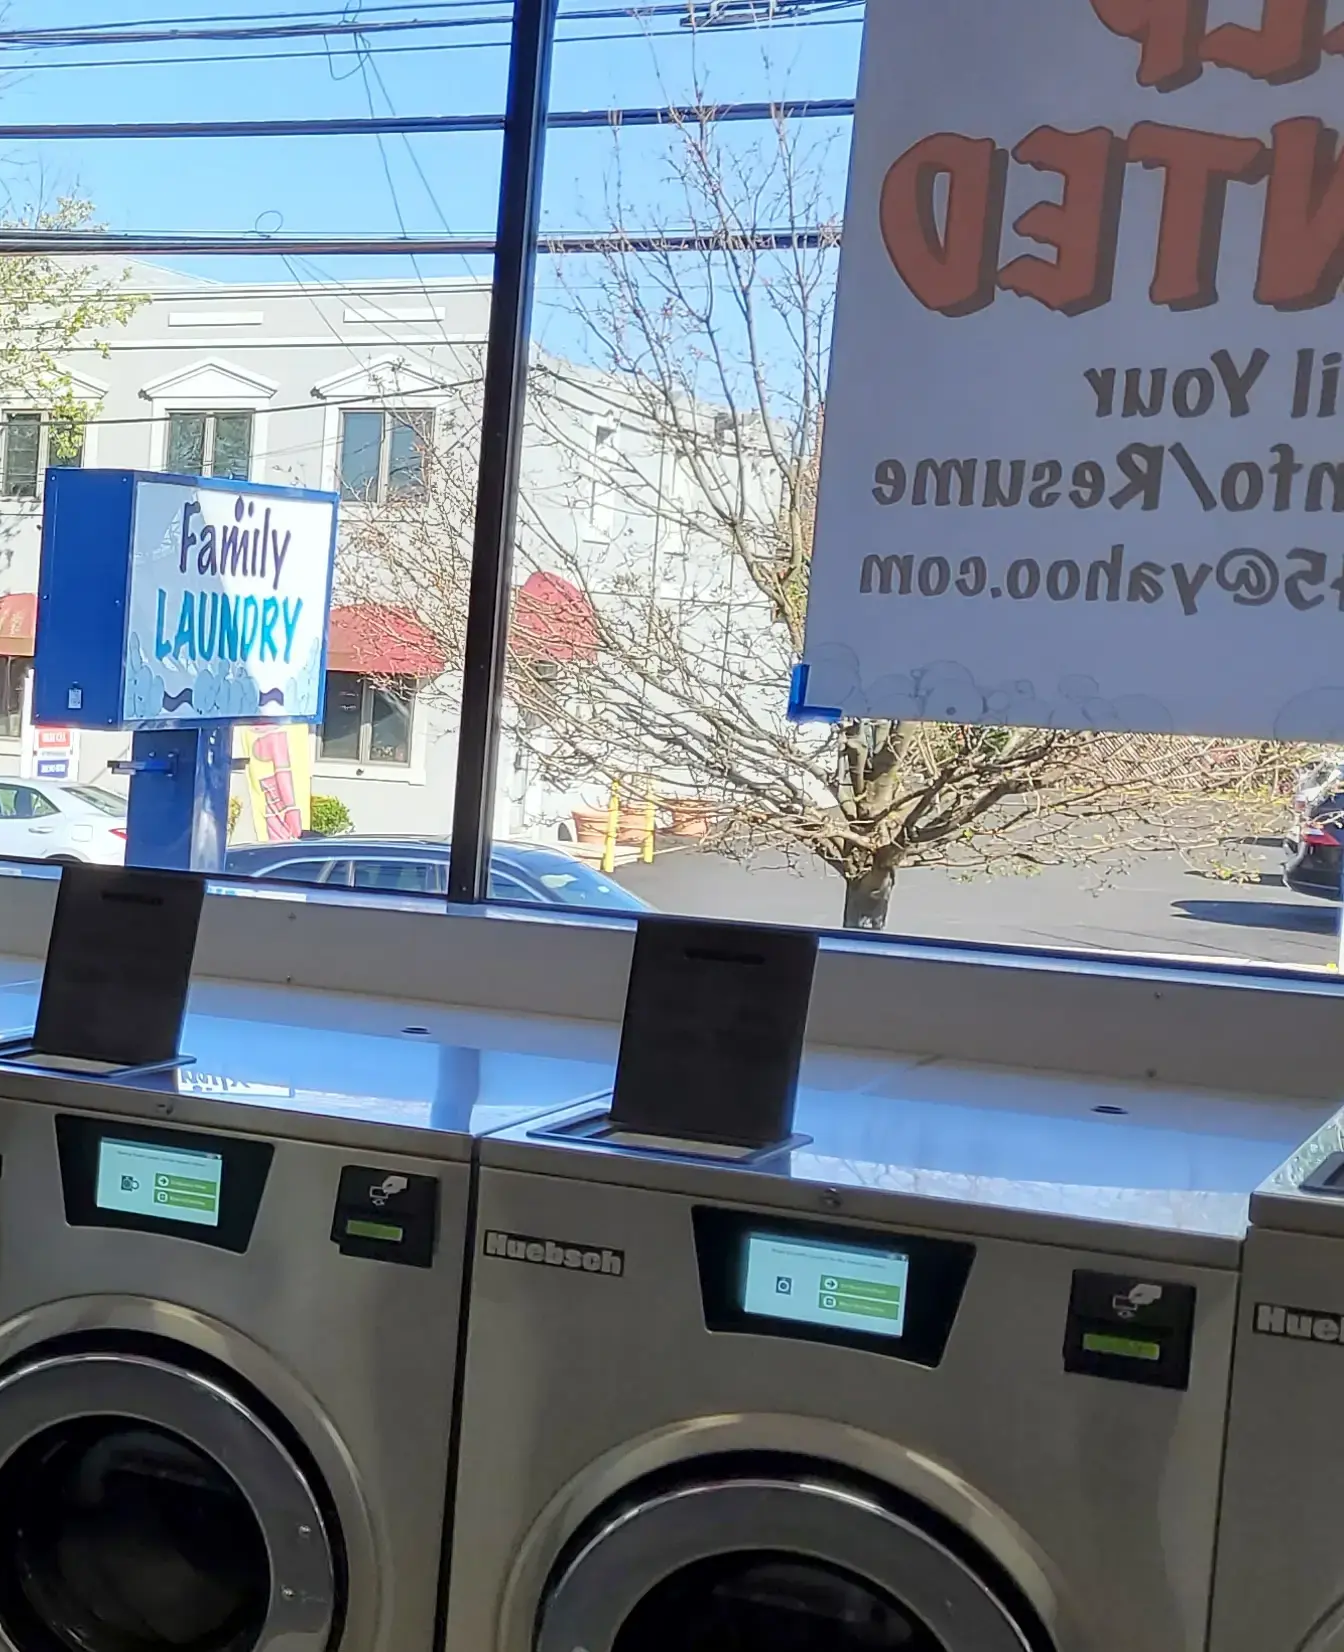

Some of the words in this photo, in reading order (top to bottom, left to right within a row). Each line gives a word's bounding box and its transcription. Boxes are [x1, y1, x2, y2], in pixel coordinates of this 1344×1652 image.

[179, 495, 292, 590] Family
[155, 588, 304, 664] LAUNDRY
[485, 1231, 622, 1276] Huebsch
[1257, 1304, 1344, 1344] Hue
